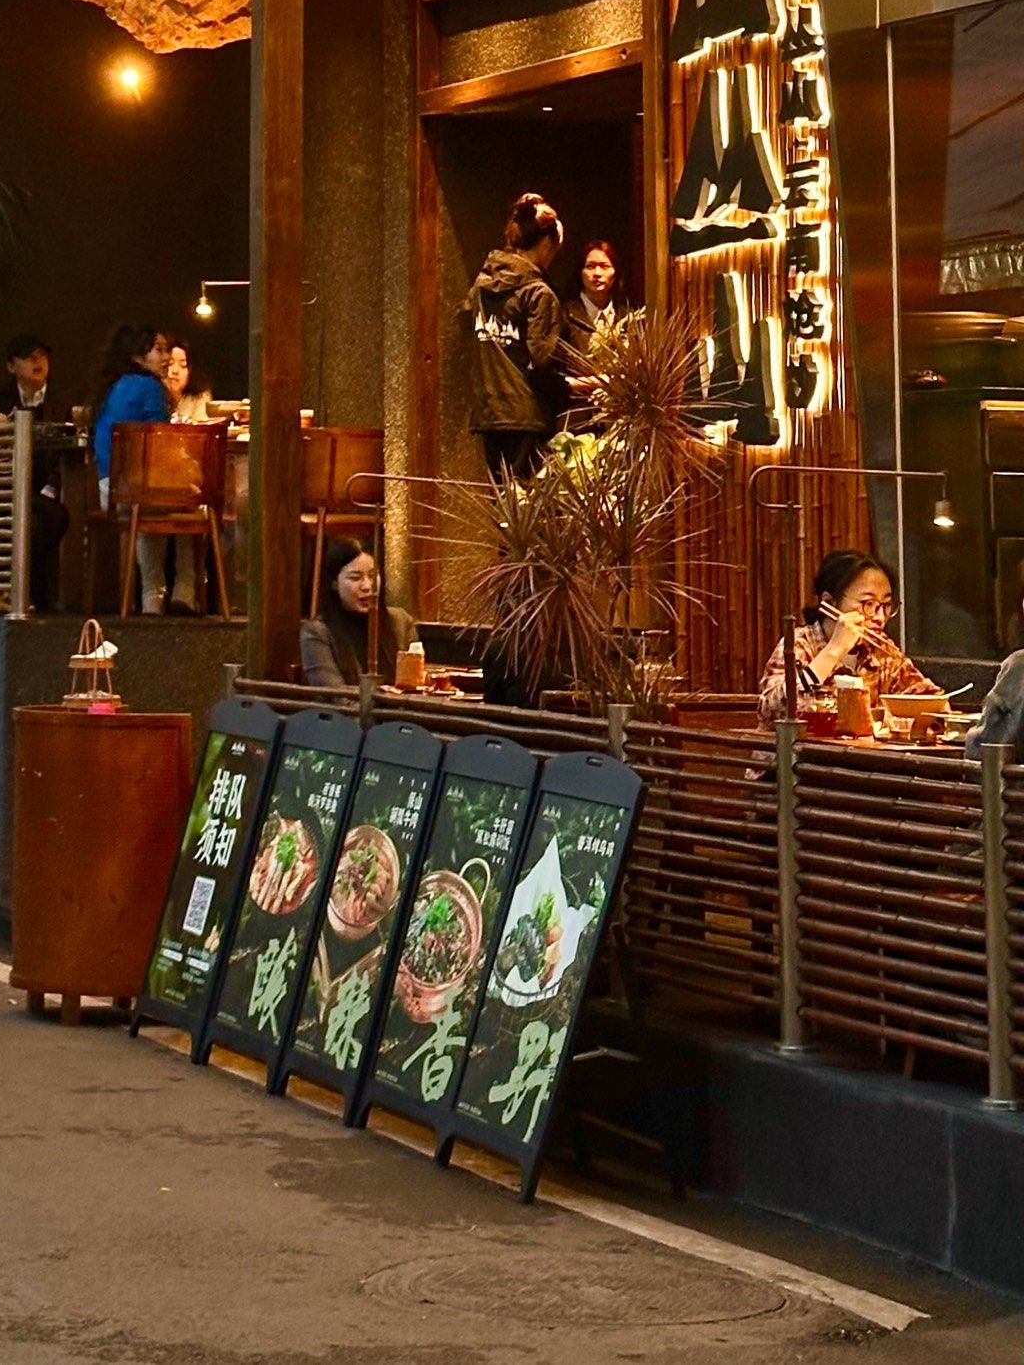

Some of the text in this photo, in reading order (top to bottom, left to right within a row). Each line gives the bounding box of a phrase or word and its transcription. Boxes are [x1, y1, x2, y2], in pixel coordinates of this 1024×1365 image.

[208, 768, 247, 821] 排队
[193, 818, 237, 869] 须知
[324, 965, 372, 1071] 辣
[401, 984, 467, 1103] 香
